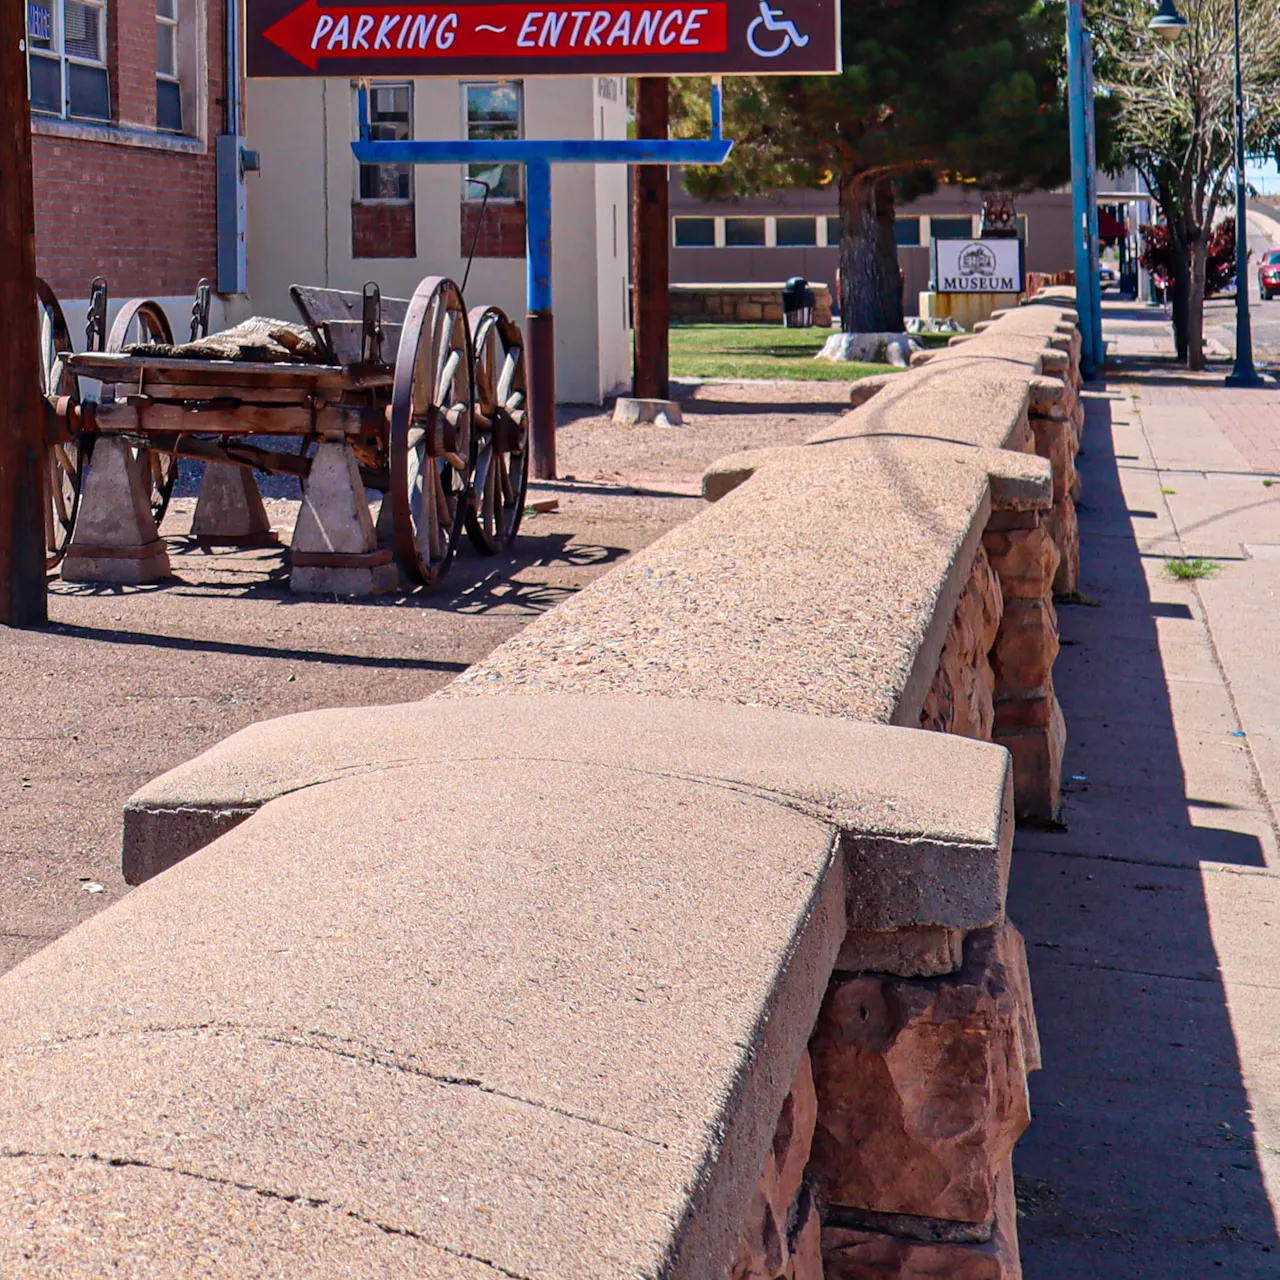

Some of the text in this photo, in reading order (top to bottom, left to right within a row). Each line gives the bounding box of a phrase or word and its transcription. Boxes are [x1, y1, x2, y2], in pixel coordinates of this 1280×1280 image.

[310, 12, 458, 51] PARKING
[516, 8, 709, 48] ENTRANCE
[943, 276, 1014, 290] MUSEUM
